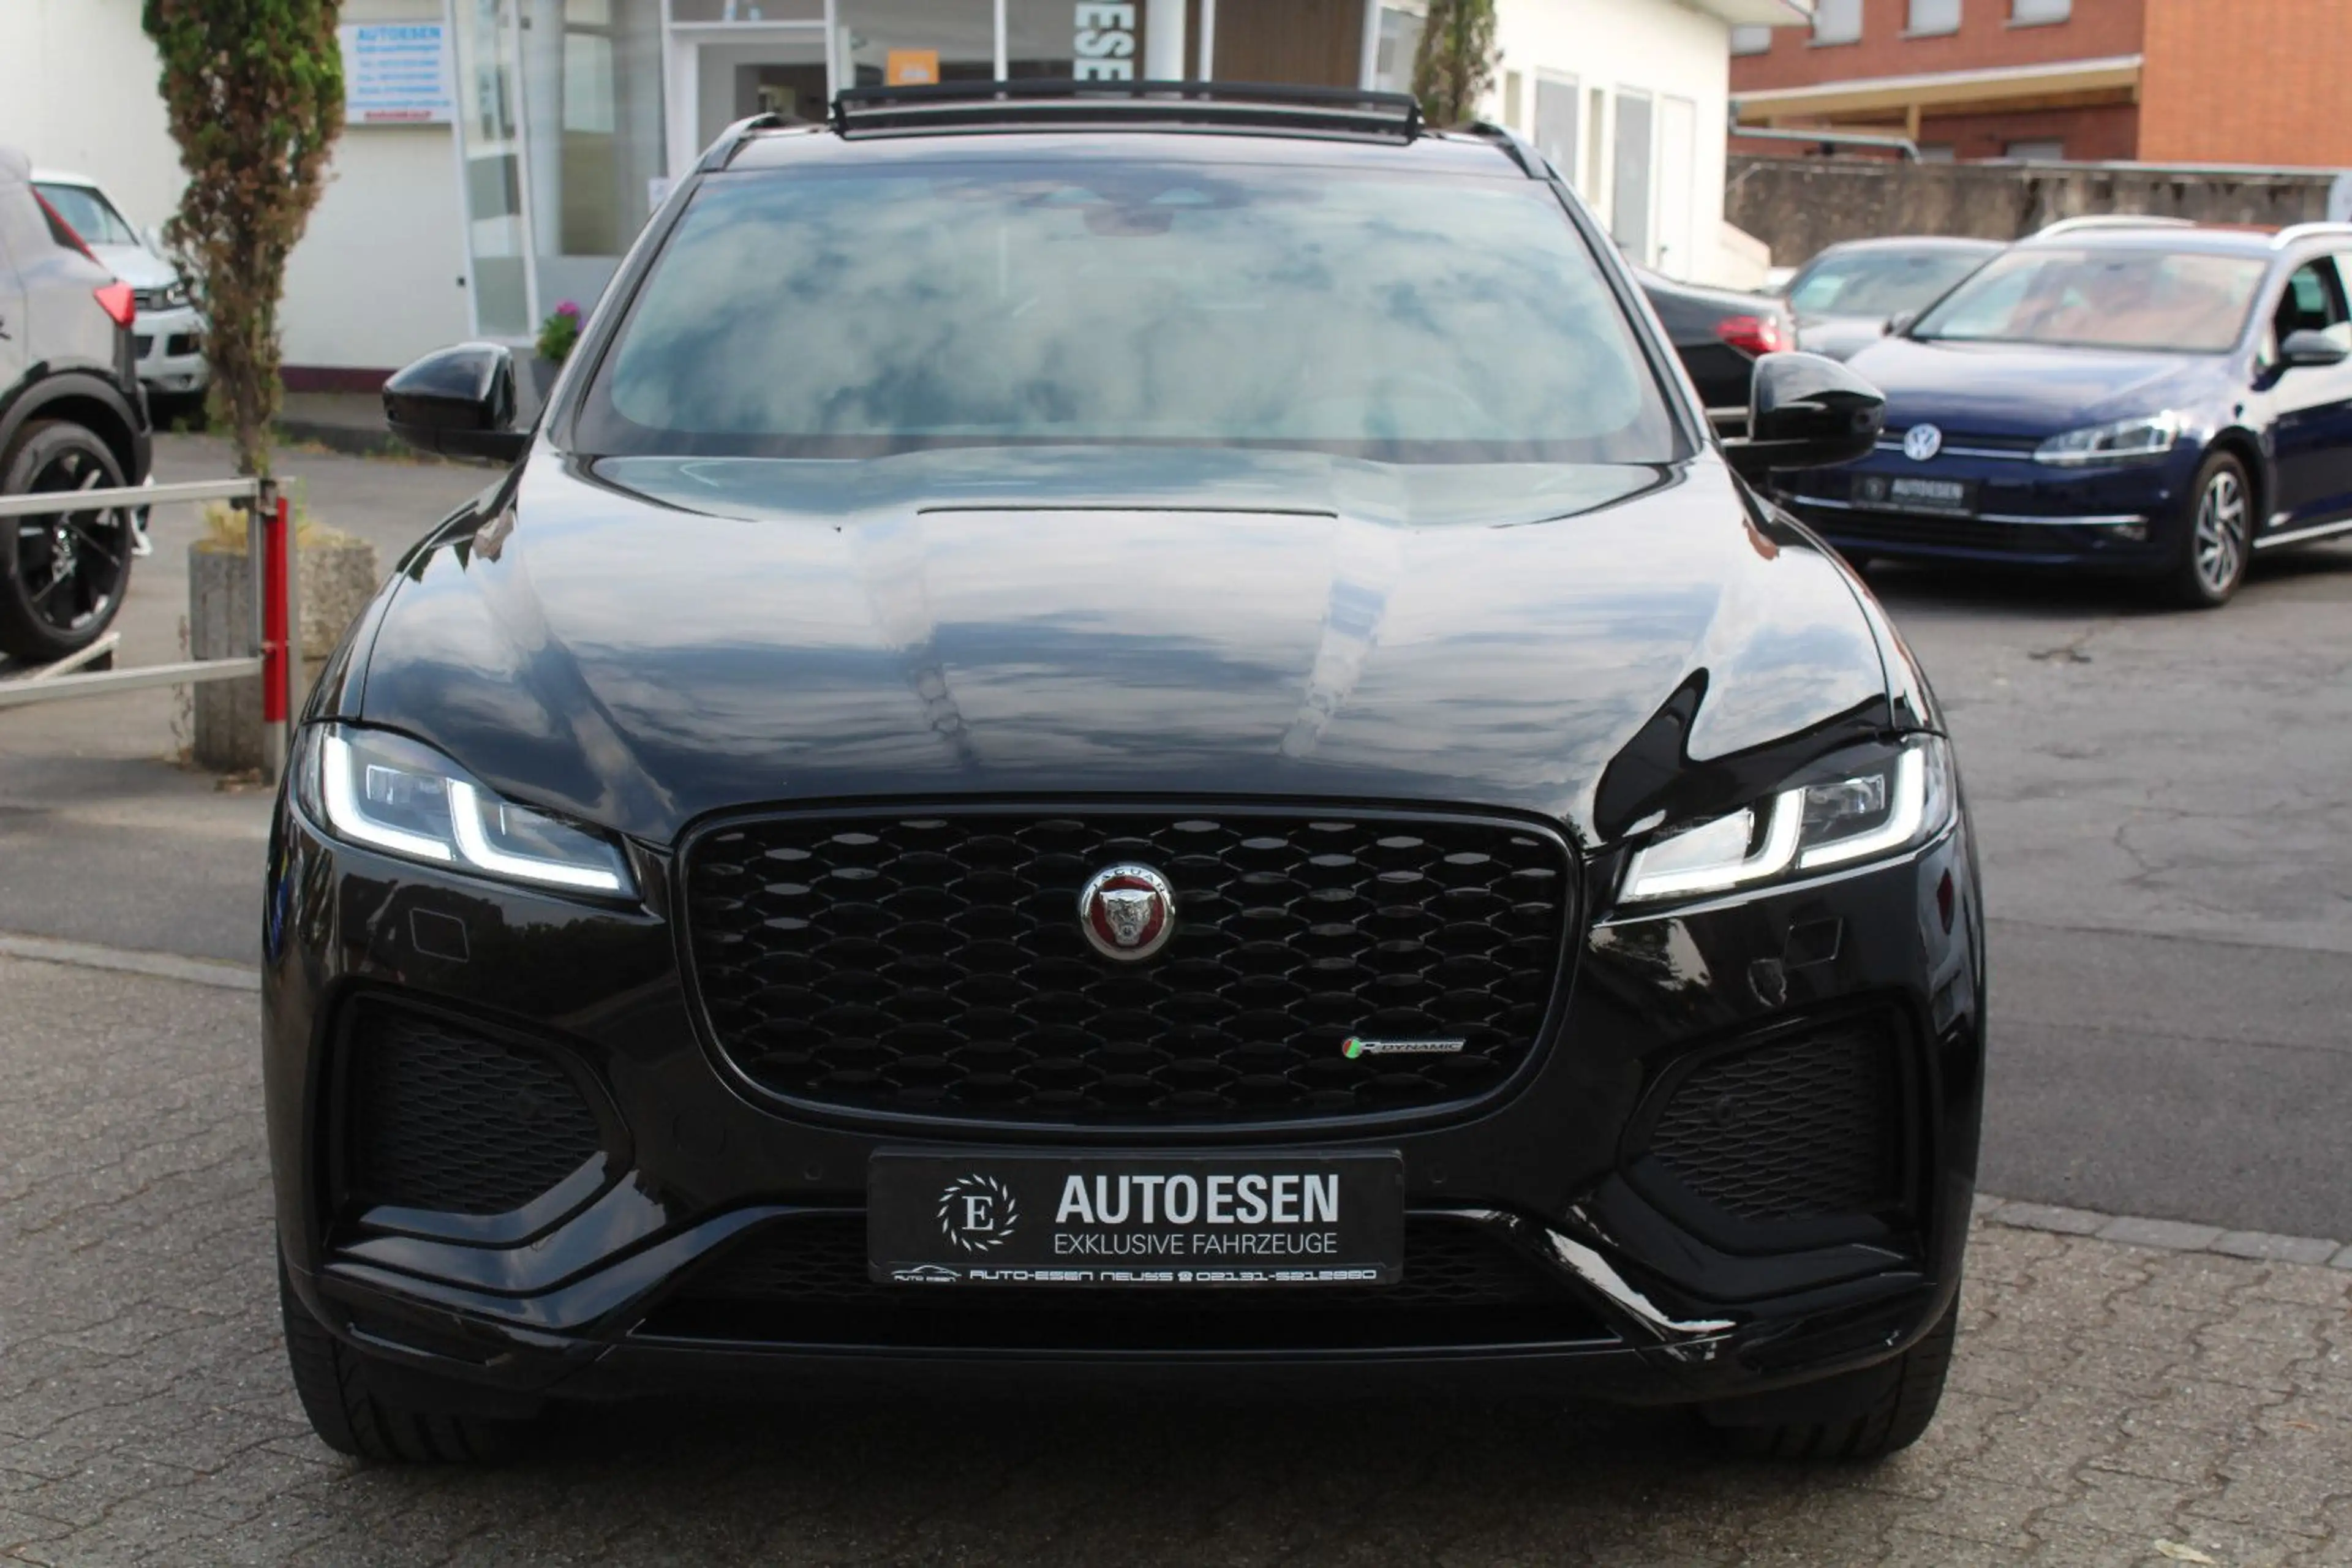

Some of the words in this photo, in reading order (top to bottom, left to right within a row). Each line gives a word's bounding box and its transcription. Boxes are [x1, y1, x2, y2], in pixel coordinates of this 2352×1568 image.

[1074, 1, 1135, 81] ESE
[1092, 867, 1166, 892] JAGUAR
[962, 1196, 993, 1231] E
[1055, 1174, 1338, 1224] AUTOESEN
[1055, 1232, 1185, 1254] EXKLUSIVE
[1193, 1232, 1337, 1254] FAHRZEUGE
[970, 1270, 1093, 1281] AUTO-ESEN
[1101, 1272, 1174, 1281] NEUSS
